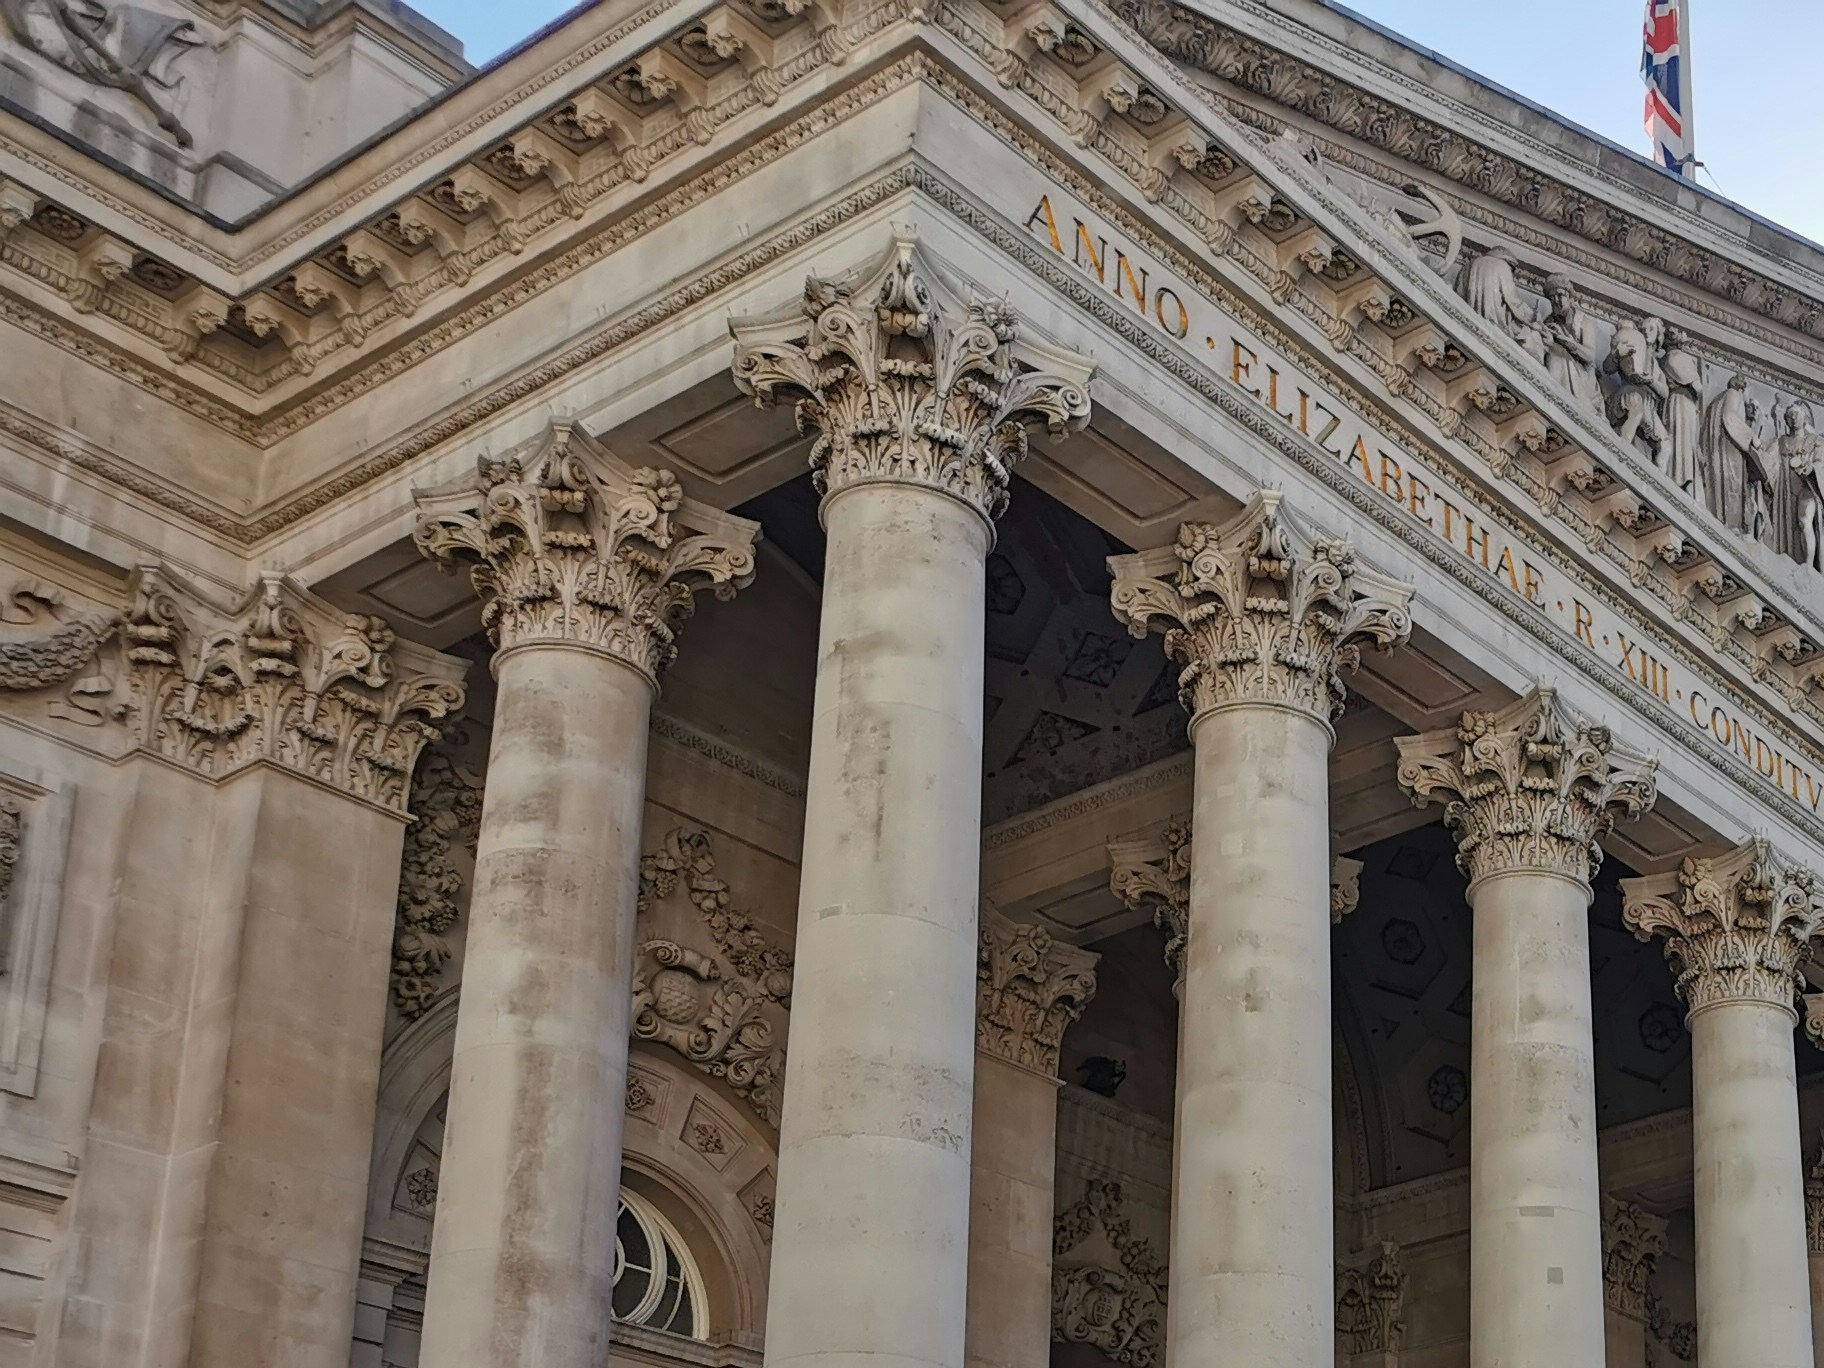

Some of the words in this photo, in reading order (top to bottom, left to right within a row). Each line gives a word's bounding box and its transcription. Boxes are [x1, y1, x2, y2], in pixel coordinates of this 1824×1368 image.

[1022, 194, 1189, 340] ANNO
[1230, 335, 1546, 612] ELIZABETHAE
[1572, 597, 1595, 650] R
[1616, 631, 1670, 705] XIII
